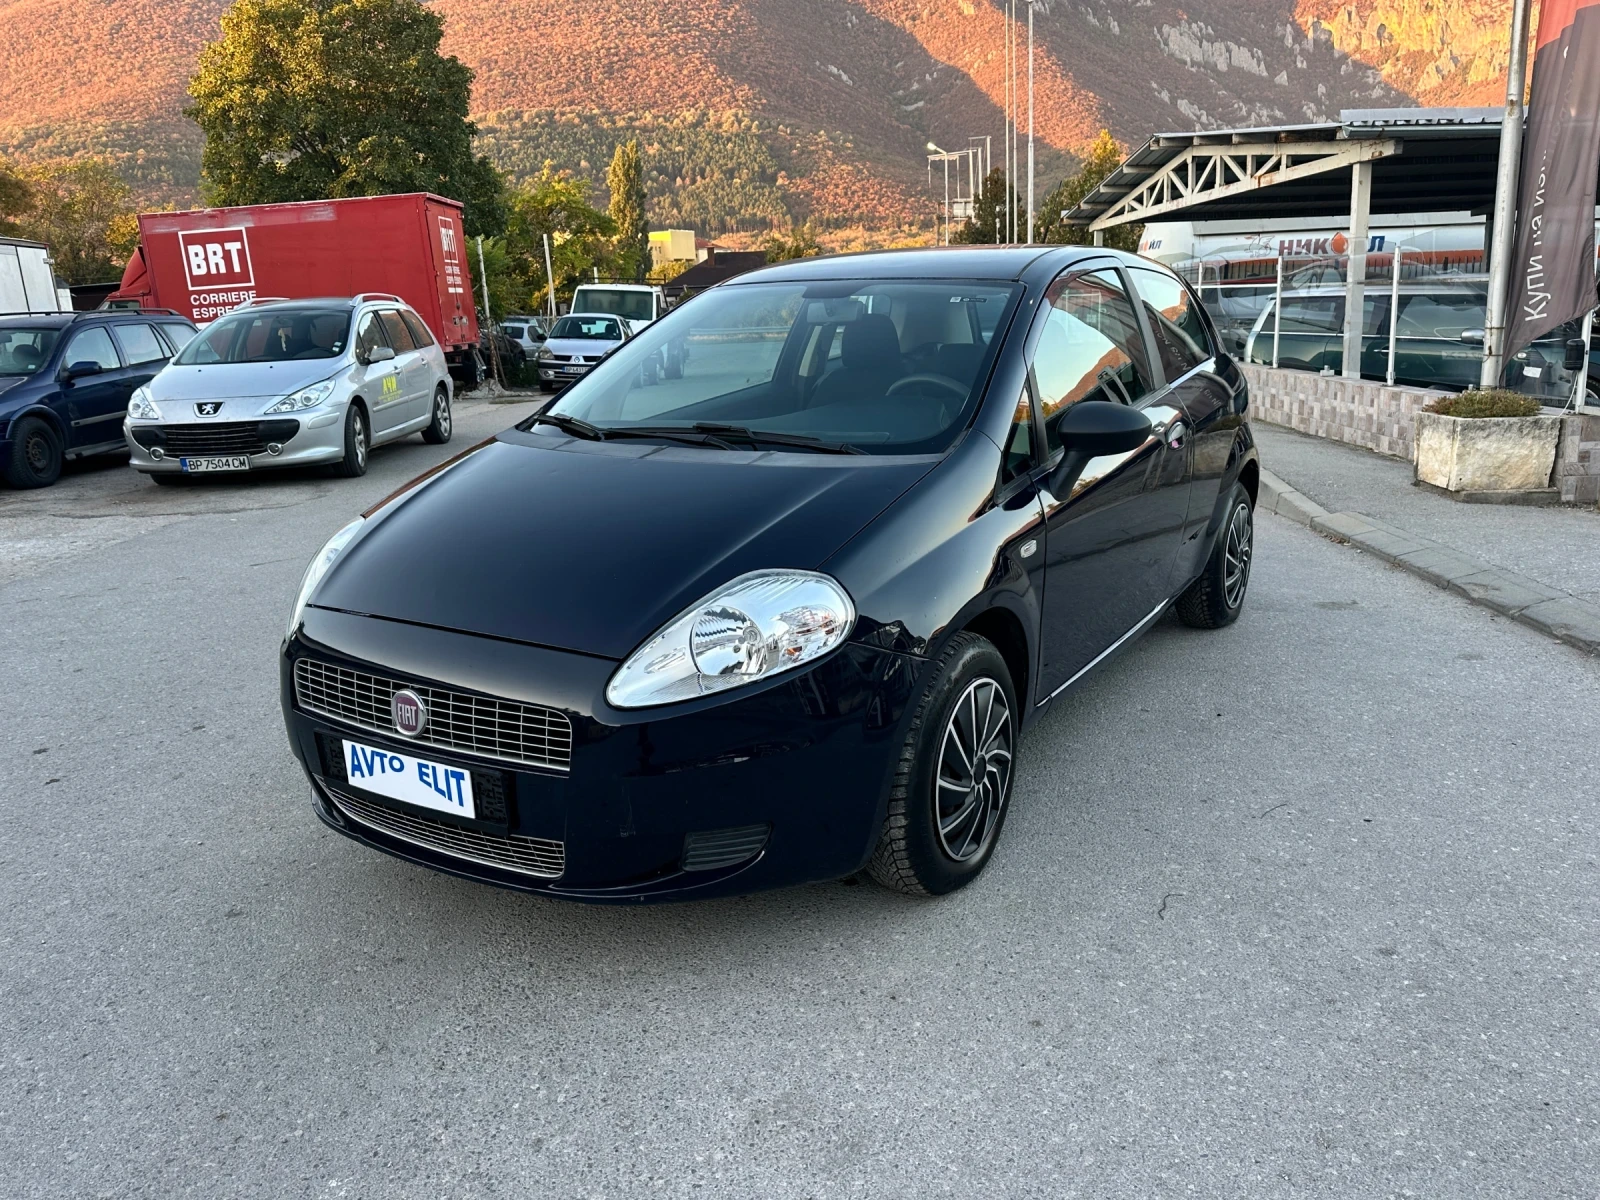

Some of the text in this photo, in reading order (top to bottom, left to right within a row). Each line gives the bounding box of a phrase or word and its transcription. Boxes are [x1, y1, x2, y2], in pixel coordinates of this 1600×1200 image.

[187, 241, 242, 275] BRT
[190, 290, 256, 305] CORRIERE
[1524, 255, 1551, 321] Купи
[192, 305, 238, 318] ESPRE
[203, 459, 230, 470] 7504
[231, 458, 246, 468] CM
[397, 703, 417, 726] FIAT
[351, 744, 465, 807] AVTO ELIT
